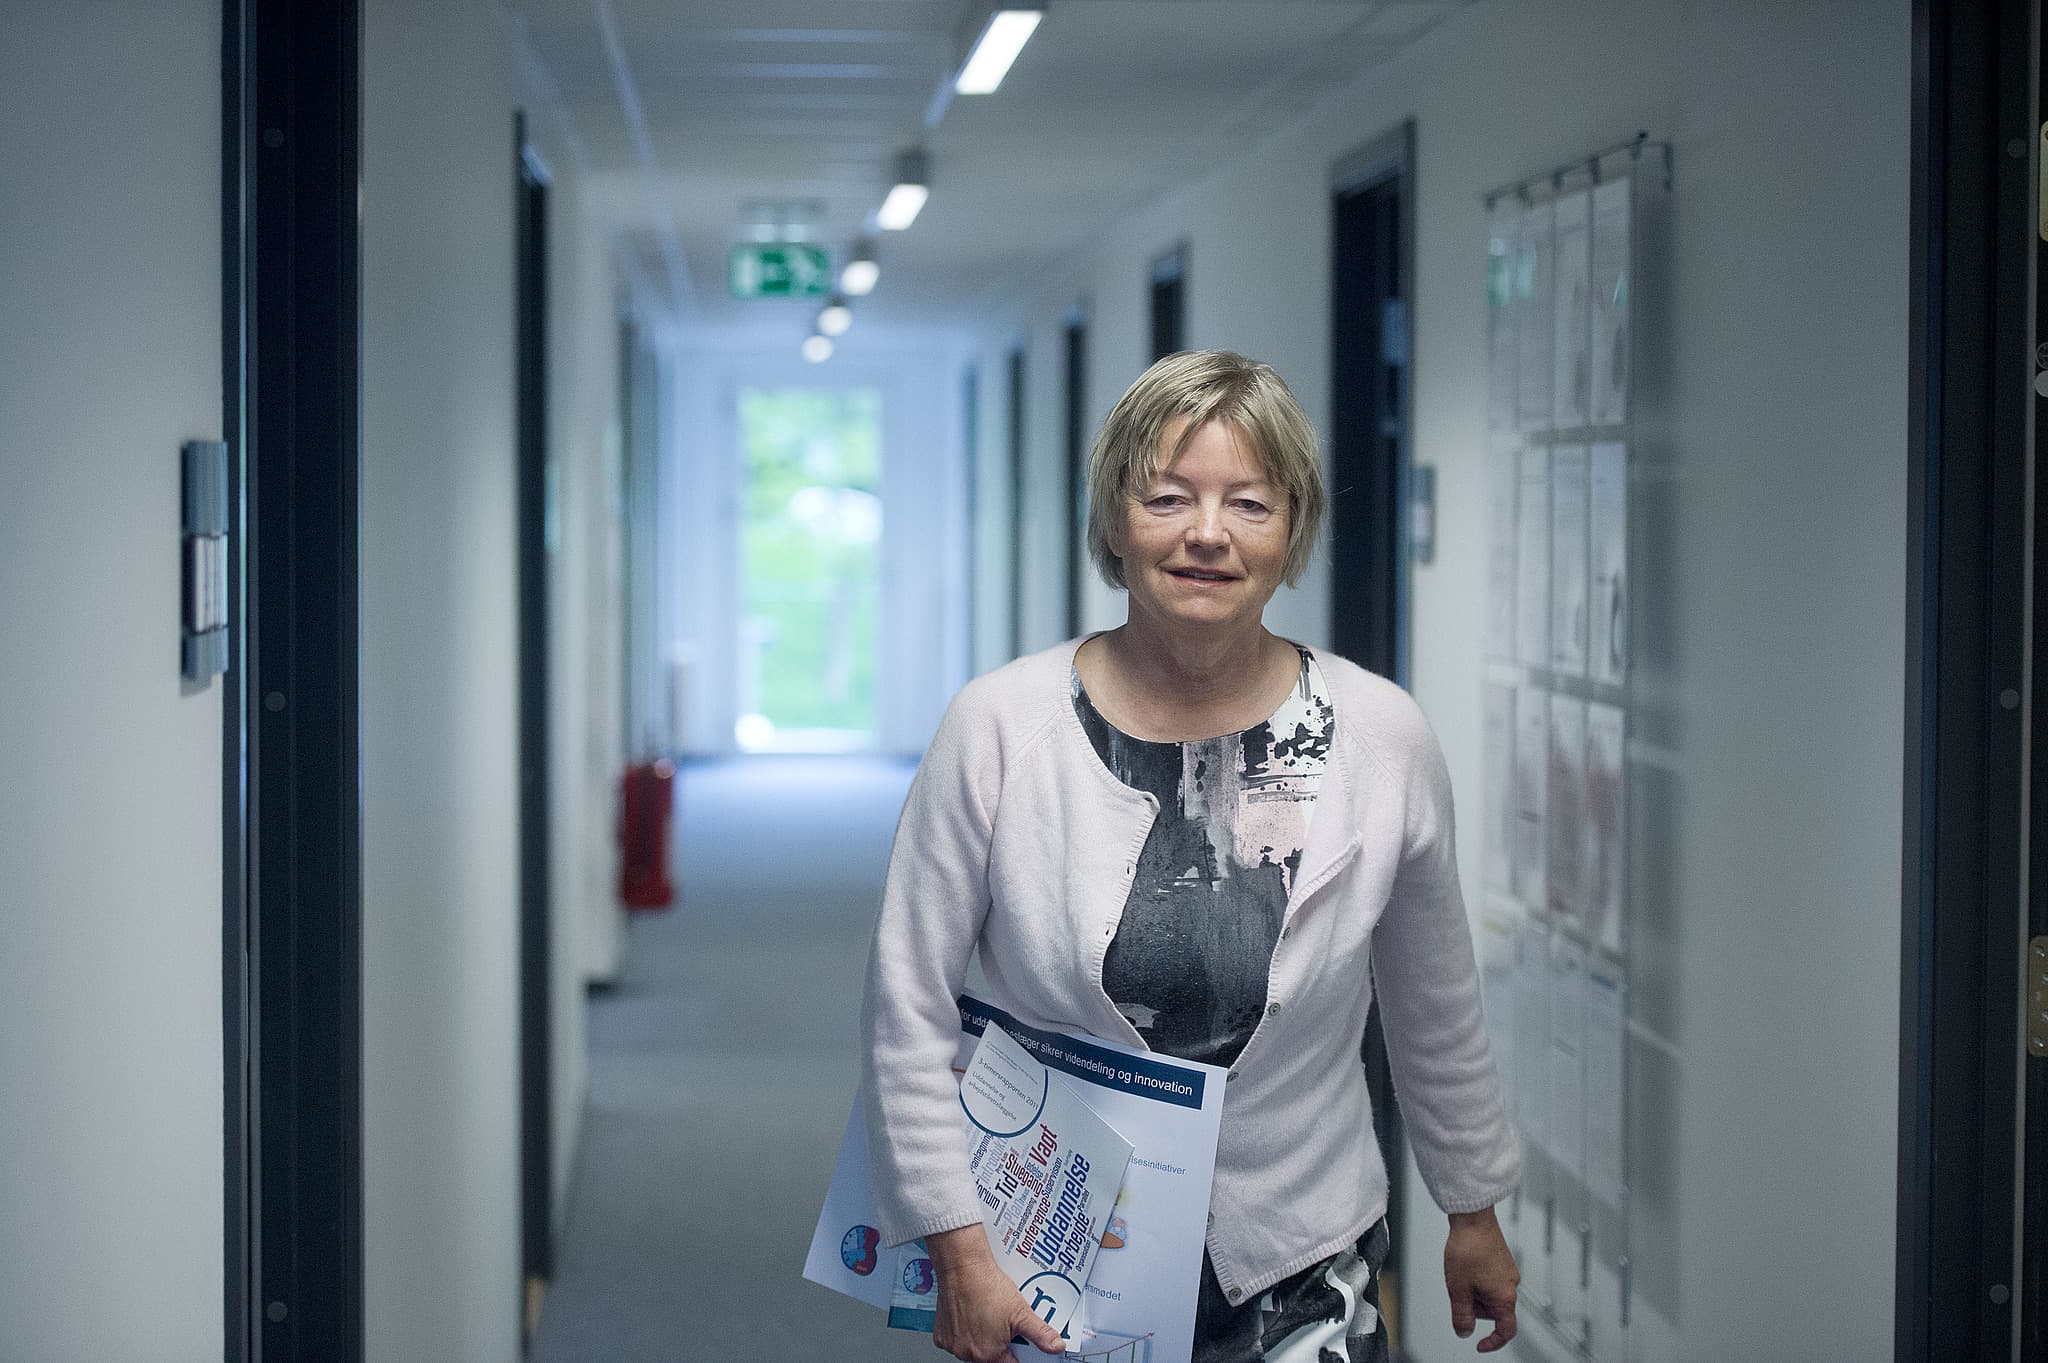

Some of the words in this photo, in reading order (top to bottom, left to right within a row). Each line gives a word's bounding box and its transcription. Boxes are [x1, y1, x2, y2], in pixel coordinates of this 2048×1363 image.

[1040, 1042, 1064, 1060] sikrer
[1064, 1051, 1116, 1080] videndeling
[1117, 1069, 1132, 1084] og
[1134, 1071, 1194, 1098] innovation
[1029, 1123, 1058, 1167] Vagt
[995, 1170, 1019, 1200] Tid
[1005, 1153, 1044, 1197] Stuegang
[1041, 1157, 1063, 1198] Supervision
[1015, 1197, 1051, 1259] Konference
[1031, 1153, 1090, 1266] Uddannelse
[1057, 1210, 1091, 1270] Arbejde
